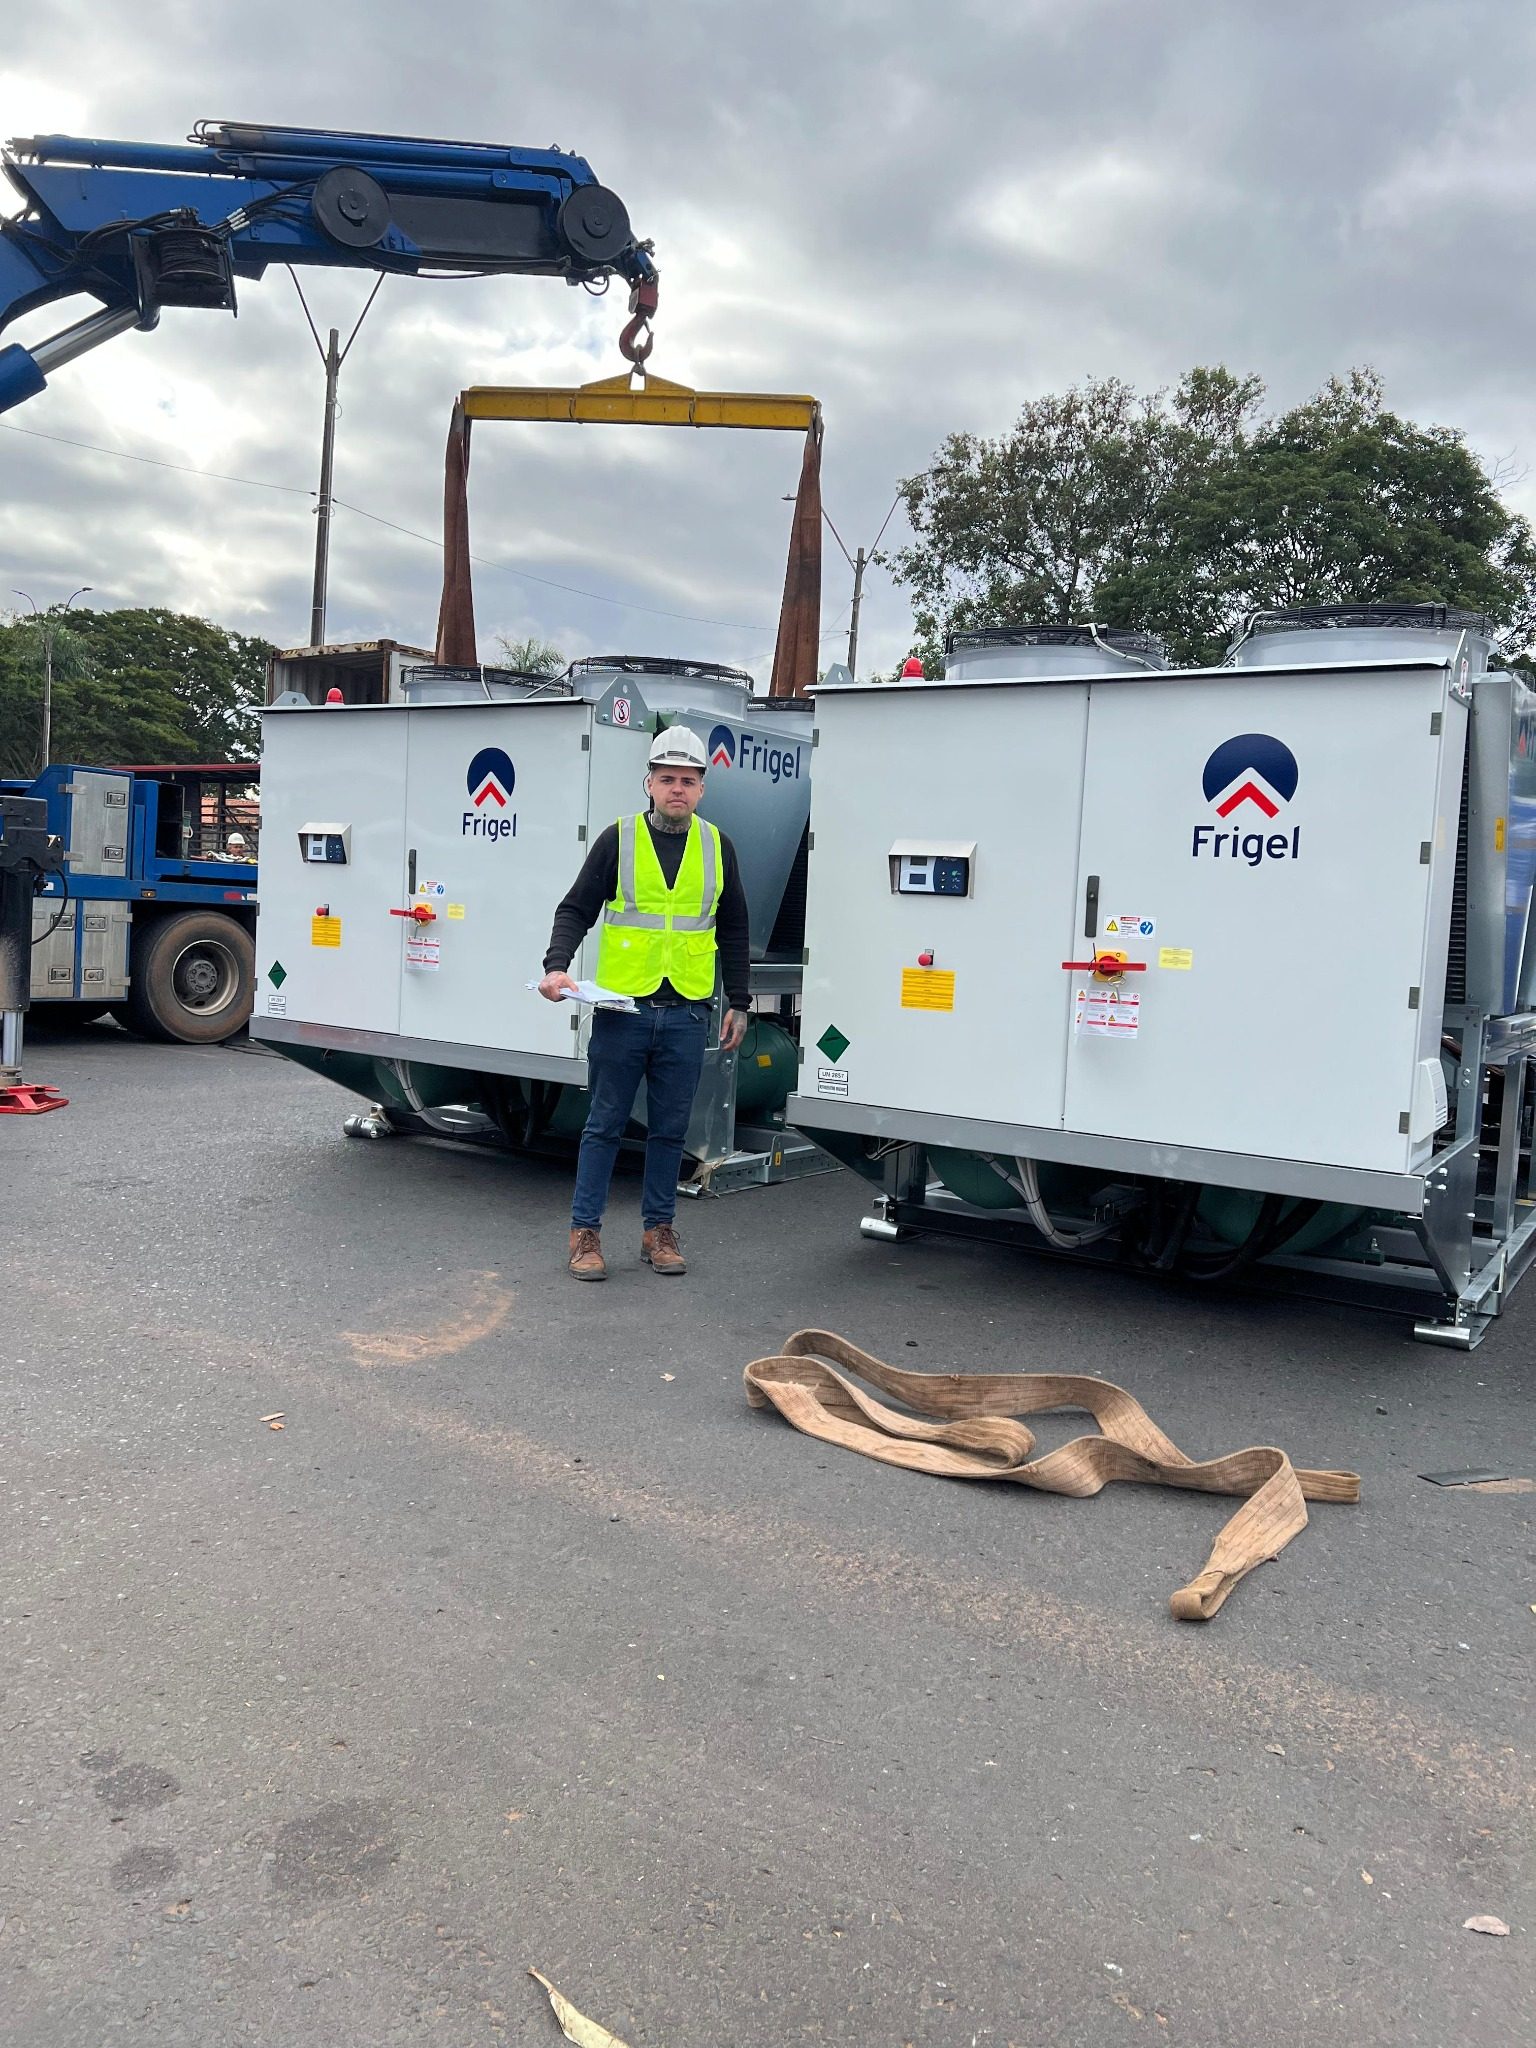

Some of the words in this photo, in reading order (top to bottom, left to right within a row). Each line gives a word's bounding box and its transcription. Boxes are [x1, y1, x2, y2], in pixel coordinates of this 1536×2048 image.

[739, 734, 801, 784] Frigel
[462, 812, 517, 843] Frigel
[1192, 825, 1300, 867] Frigel
